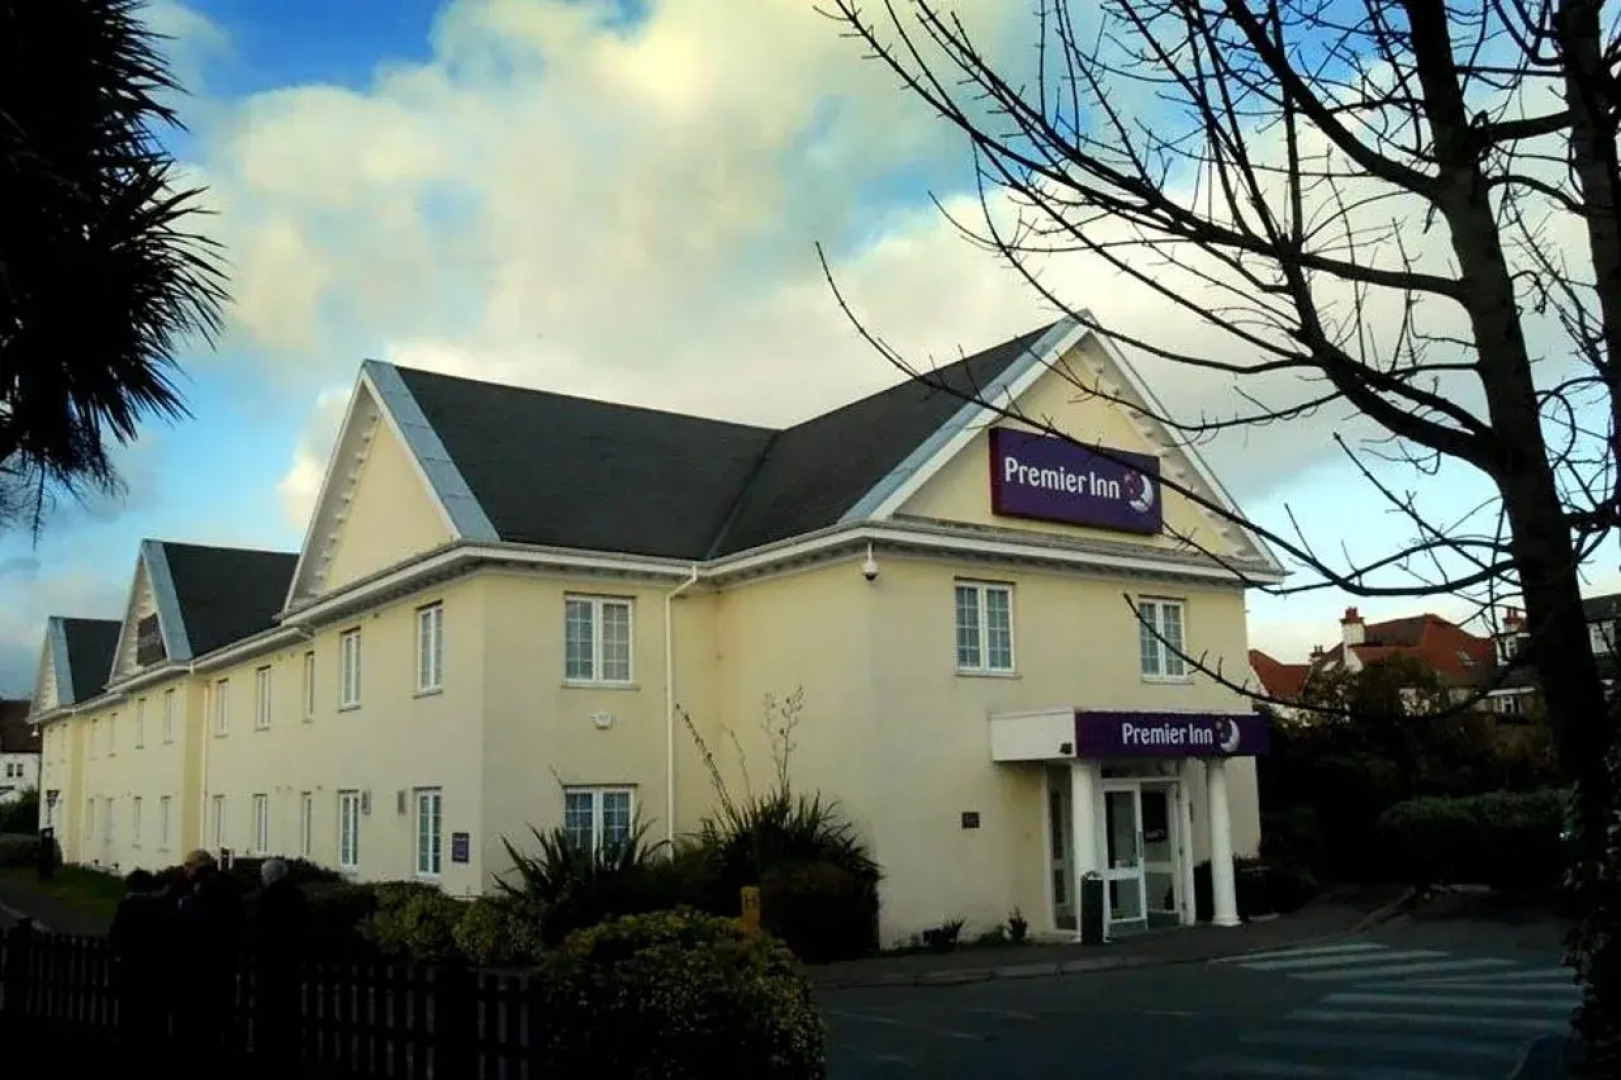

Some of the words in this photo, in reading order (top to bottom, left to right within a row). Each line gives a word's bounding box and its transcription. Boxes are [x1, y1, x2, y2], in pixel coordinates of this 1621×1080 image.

[1004, 457, 1087, 494] Premier
[1090, 471, 1120, 499] Inn
[1121, 723, 1187, 745] Premier
[1189, 723, 1213, 744] Inn
